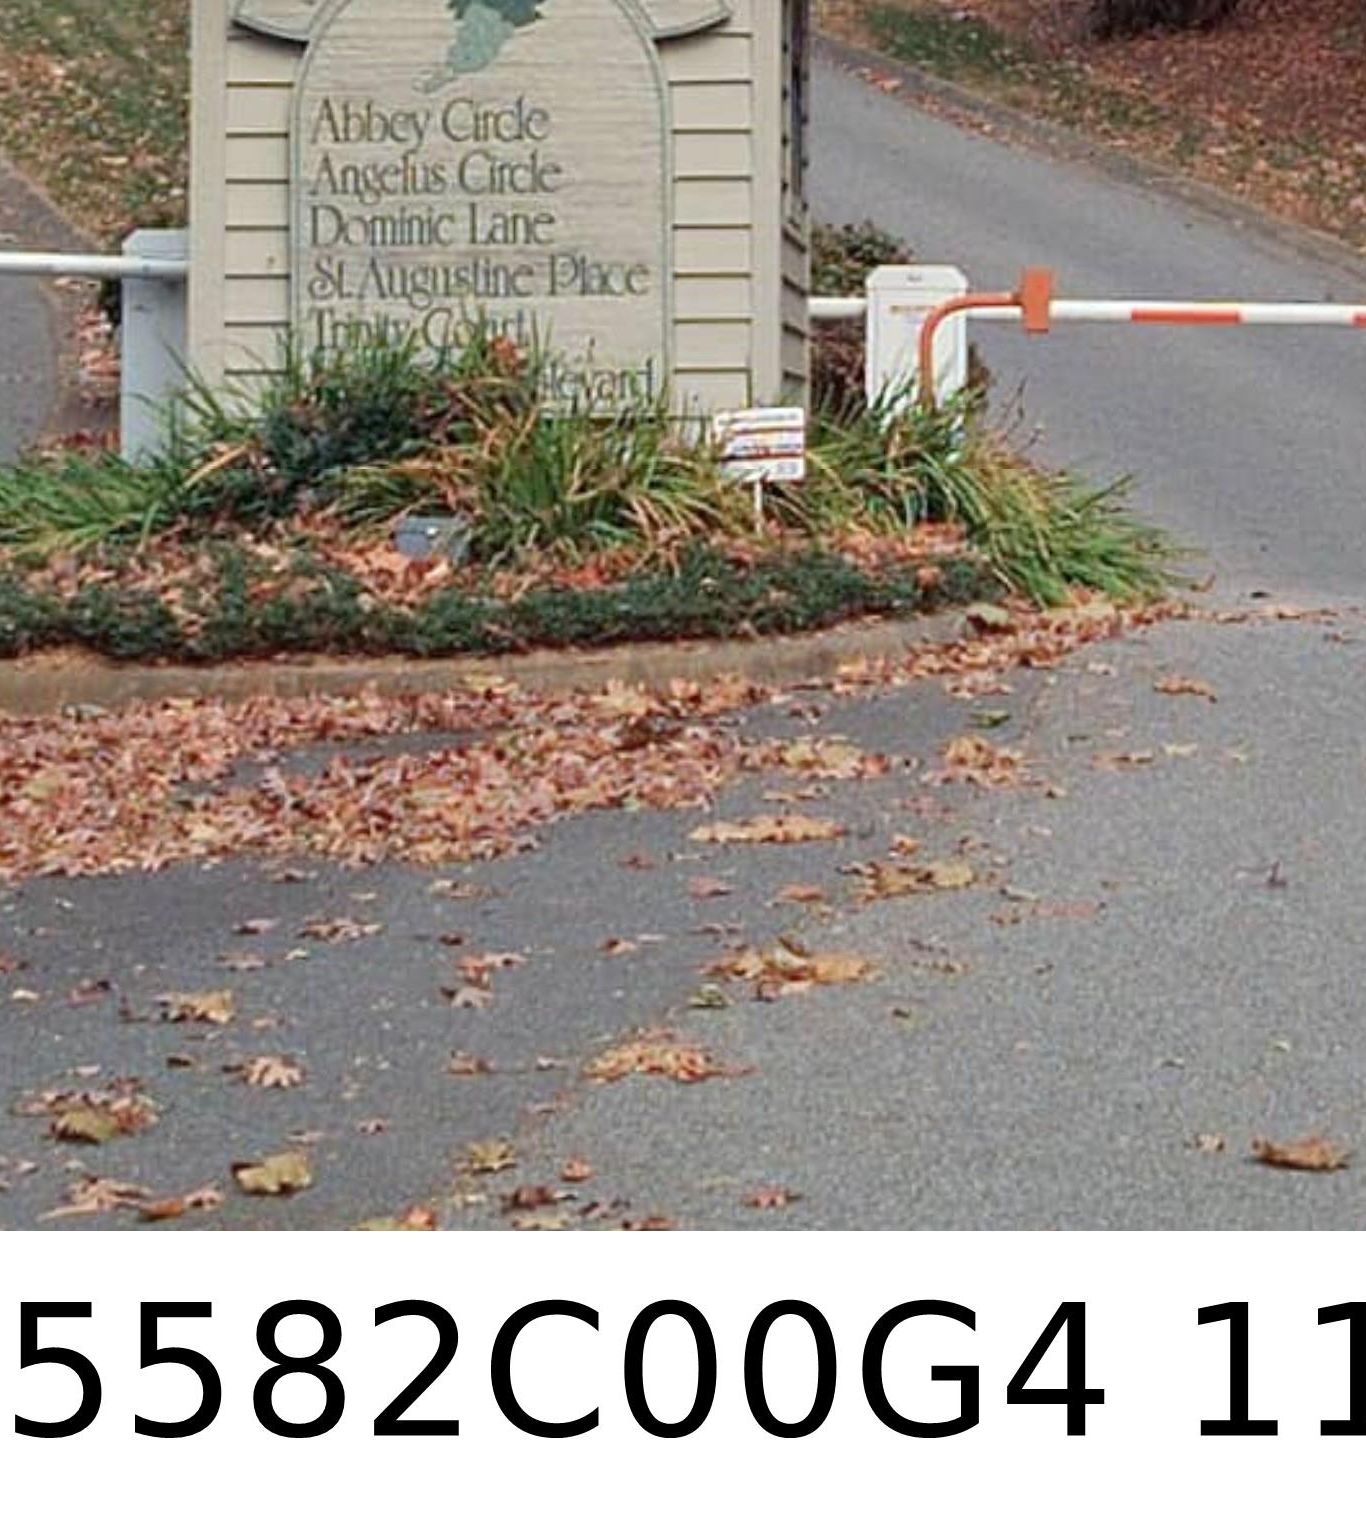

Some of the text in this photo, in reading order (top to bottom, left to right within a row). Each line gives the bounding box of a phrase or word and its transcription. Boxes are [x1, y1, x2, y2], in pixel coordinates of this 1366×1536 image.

[309, 96, 551, 151] Abbey Circle
[308, 148, 563, 205] Angelus Circle
[309, 202, 556, 248] Dominic Lane
[357, 255, 535, 310] Augustine
[547, 253, 651, 297] Place
